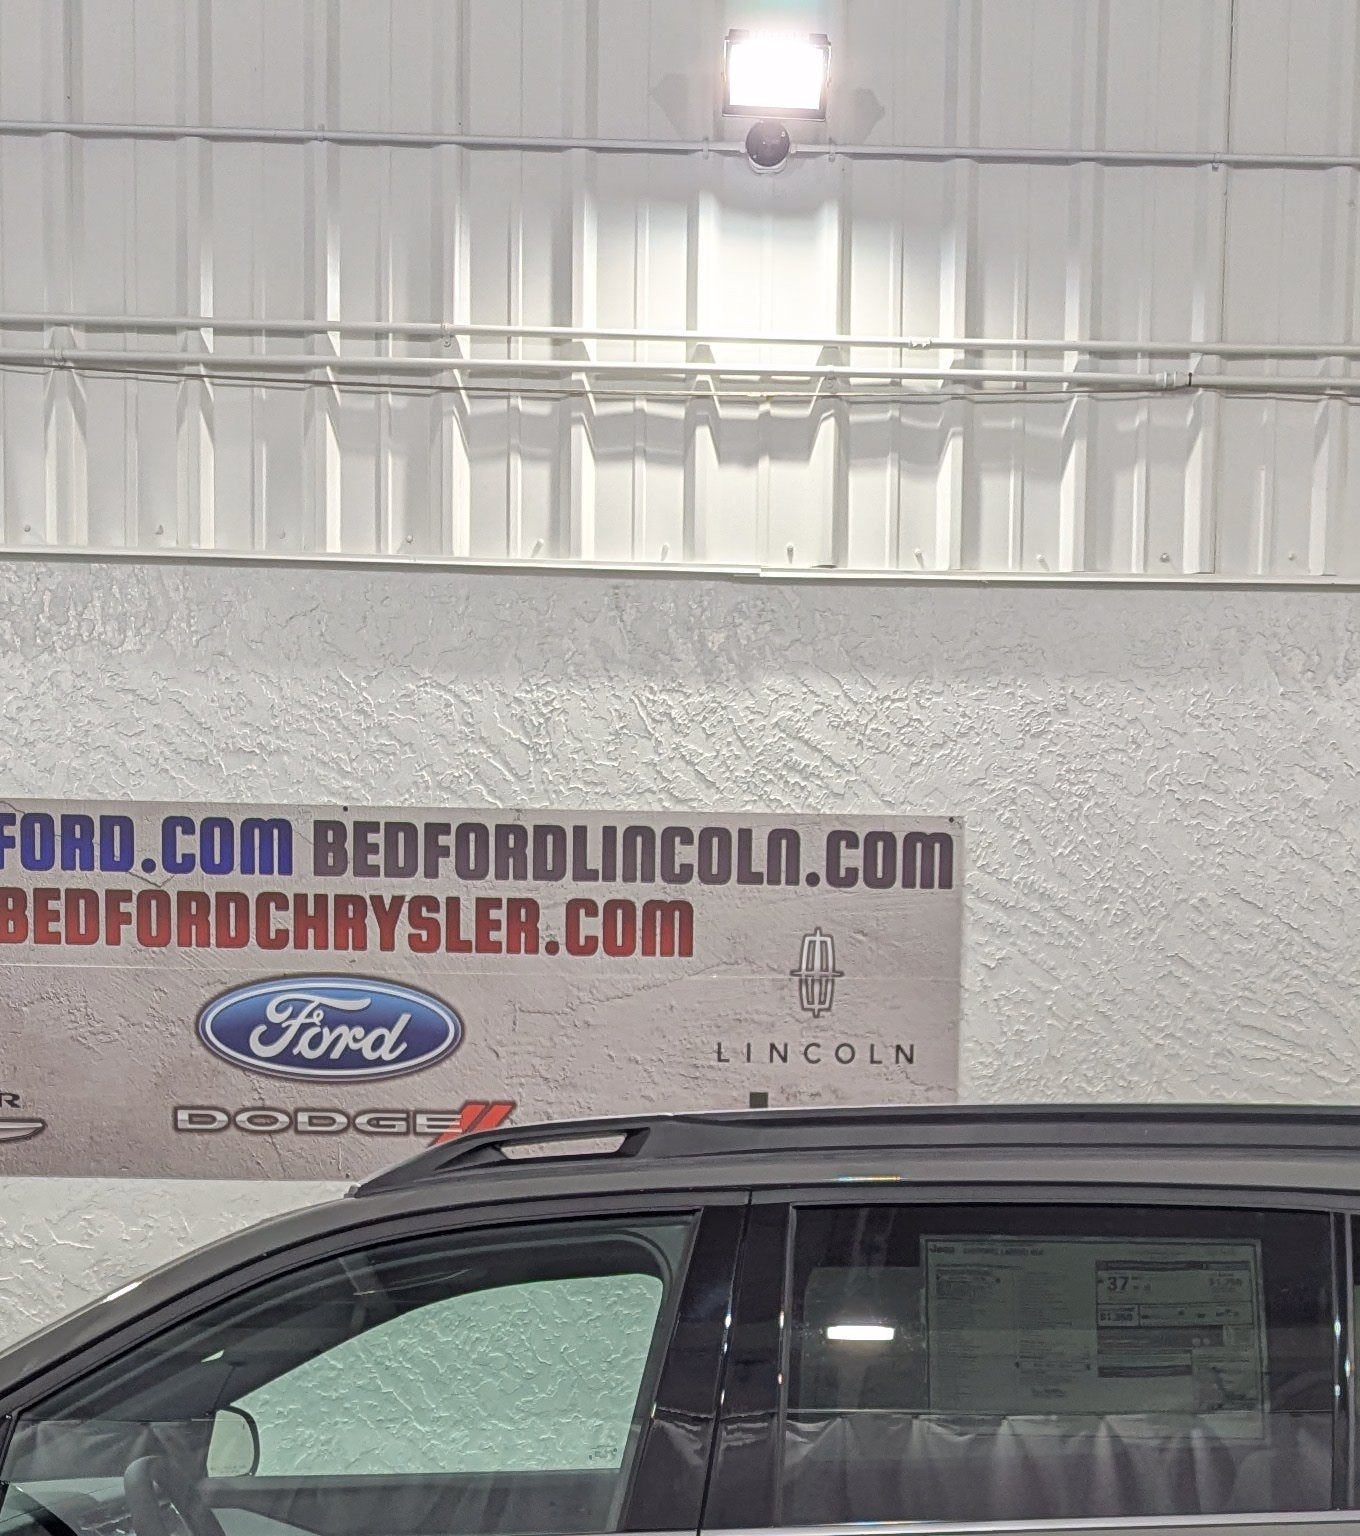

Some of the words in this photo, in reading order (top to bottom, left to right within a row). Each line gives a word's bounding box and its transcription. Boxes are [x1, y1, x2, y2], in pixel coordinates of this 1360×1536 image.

[312, 819, 955, 890] BEDFORDLINCOLN.COM
[249, 994, 412, 1061] Ford
[716, 1042, 914, 1064] LINCOLN
[175, 1105, 464, 1136] DODGE
